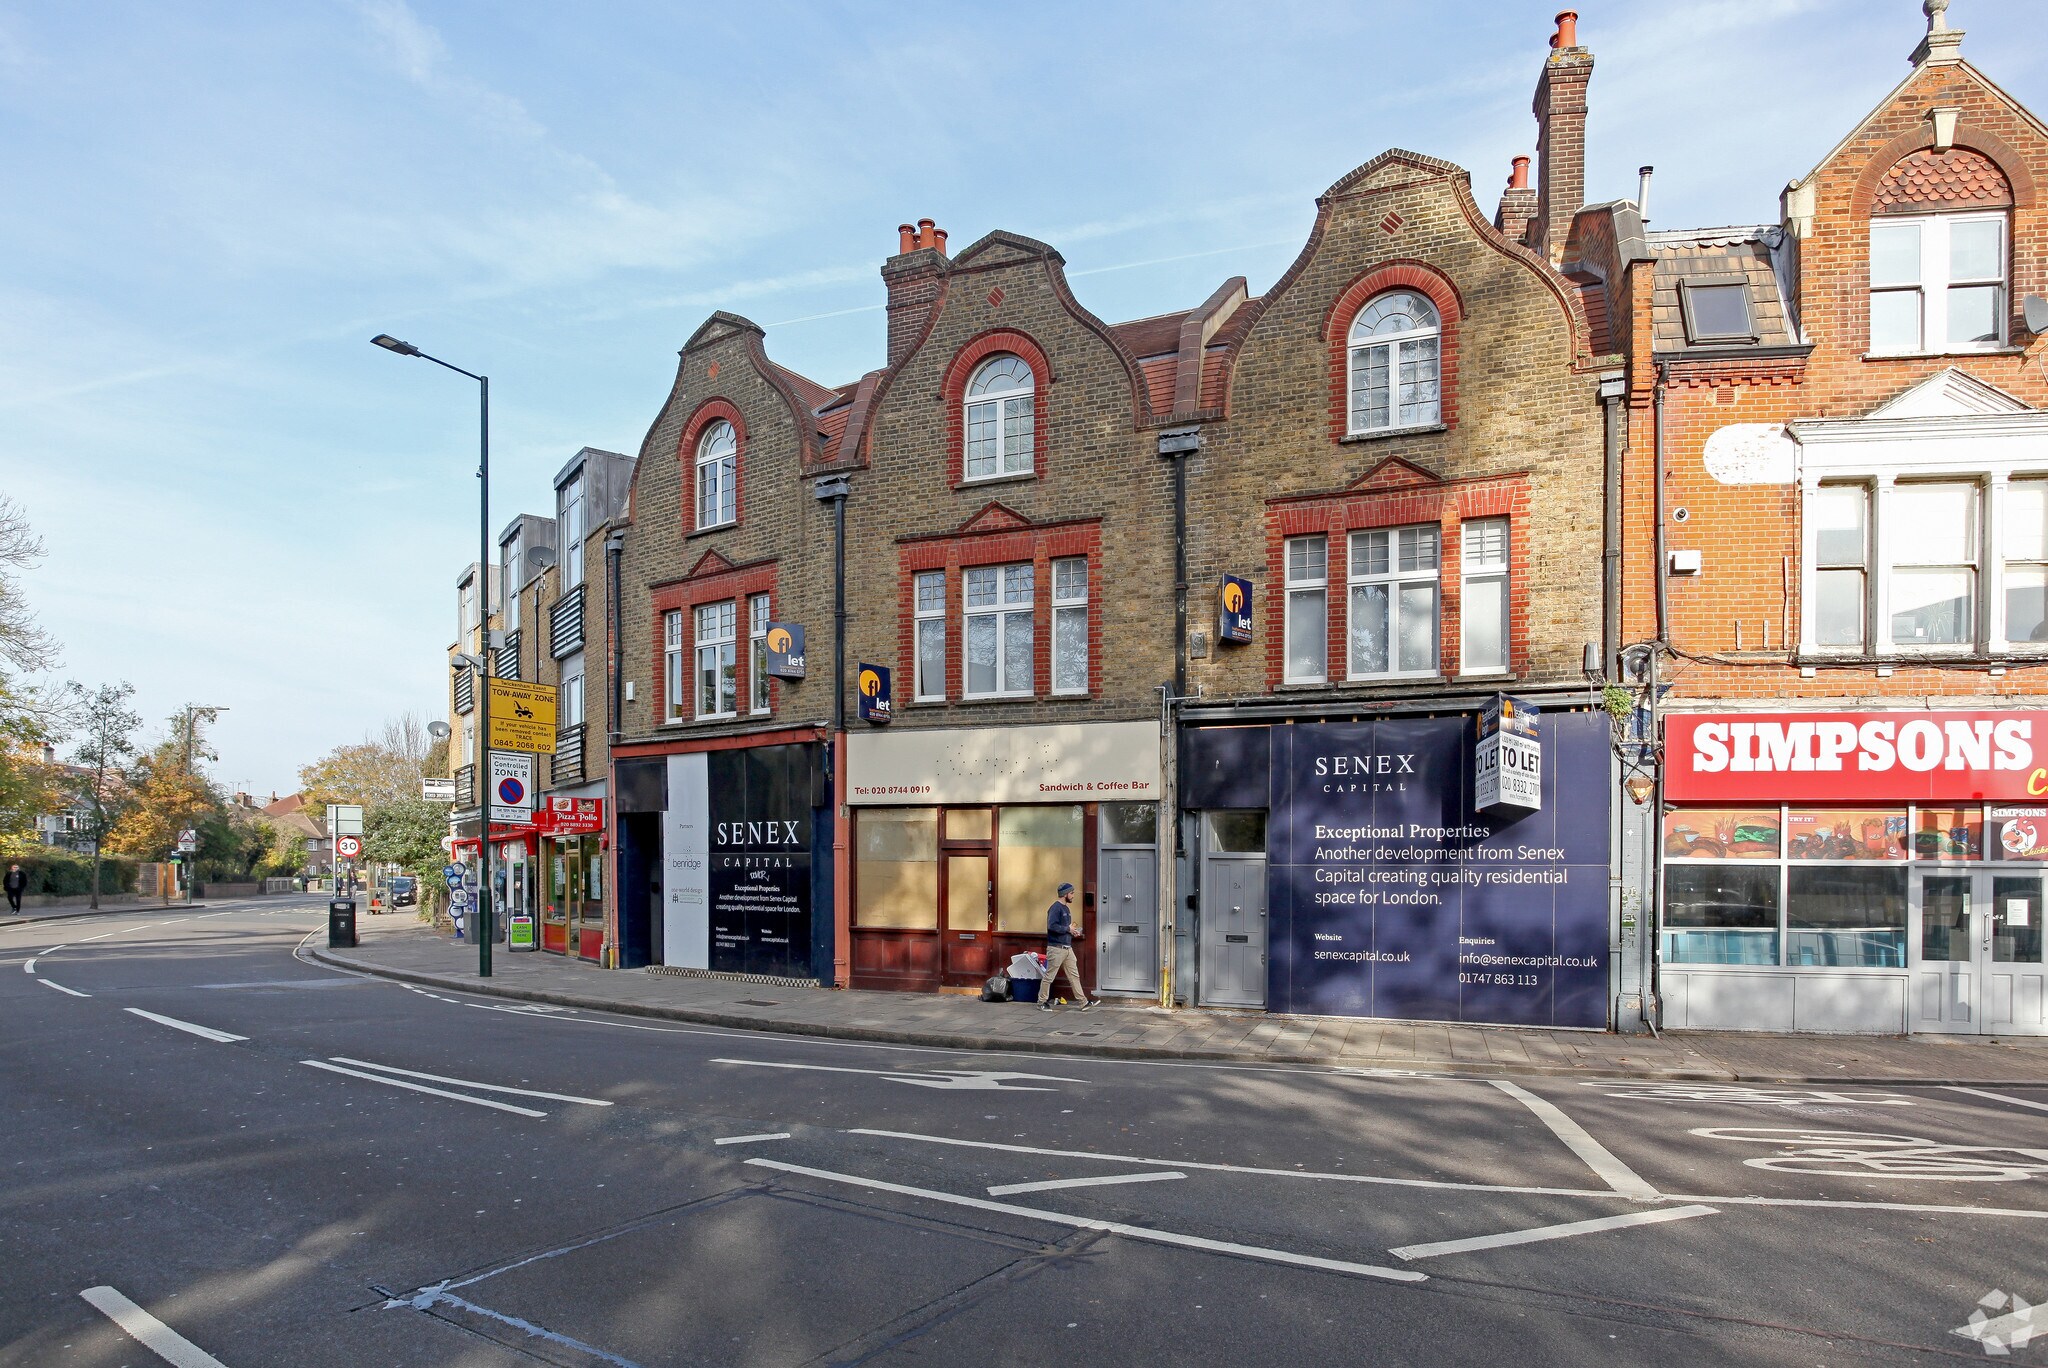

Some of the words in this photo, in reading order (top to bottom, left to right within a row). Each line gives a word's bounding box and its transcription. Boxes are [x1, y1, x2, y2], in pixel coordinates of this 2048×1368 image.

[1238, 615, 1251, 630] let
[788, 654, 804, 667] let
[492, 688, 531, 700] TOW-AWAY
[535, 694, 554, 703] ZONE
[876, 698, 890, 711] let
[494, 739, 513, 747] 0845
[1693, 719, 2033, 772] SIMPSONS
[494, 761, 528, 769] Controlled
[1315, 754, 1415, 776] SENEX
[1485, 746, 1499, 771] LET
[1502, 746, 1516, 768] TO
[1521, 751, 1539, 773] LET
[495, 769, 519, 777] ZONE
[855, 787, 869, 795] Tel:
[871, 786, 886, 794] 020
[888, 786, 908, 794] 8744
[910, 785, 931, 793] 0919
[1039, 782, 1083, 791] Sandwich
[1086, 782, 1093, 791] &
[1096, 781, 1128, 791] Coffee
[1132, 781, 1149, 790] Bar
[1323, 783, 1406, 793] CAPITAL
[1502, 775, 1511, 790] 020
[1513, 778, 1527, 794] 8332
[555, 812, 576, 821] Pizza
[576, 813, 598, 821] Pollo
[1992, 808, 2046, 817] SIMPSONS
[717, 820, 799, 845] SENEX
[1315, 825, 1404, 842] Exceptional
[1410, 824, 1490, 841] Properties
[341, 842, 357, 850] 30
[1315, 846, 1372, 860] Another
[1375, 846, 1474, 863] development
[1477, 846, 1513, 860] from
[1517, 846, 1565, 860] Senex
[724, 857, 792, 867] CAPITAL
[1315, 869, 1364, 887] Capital
[1368, 869, 1427, 886] creating
[1431, 869, 1482, 887] quality
[1486, 869, 1568, 884] residential
[734, 884, 758, 893] Exceptional
[759, 885, 780, 893] Properties
[1315, 891, 1355, 906] space
[1359, 889, 1380, 904] for
[1382, 890, 1443, 905] London.
[1314, 933, 1342, 941] Website
[1459, 936, 1495, 945] Enquiries
[1314, 950, 1411, 963] senexcapital.co.uk
[1459, 953, 1598, 969] info@senexcapital.co.uk
[1459, 973, 1492, 984] 01747
[1494, 974, 1515, 985] 863
[1517, 974, 1538, 986] 113
